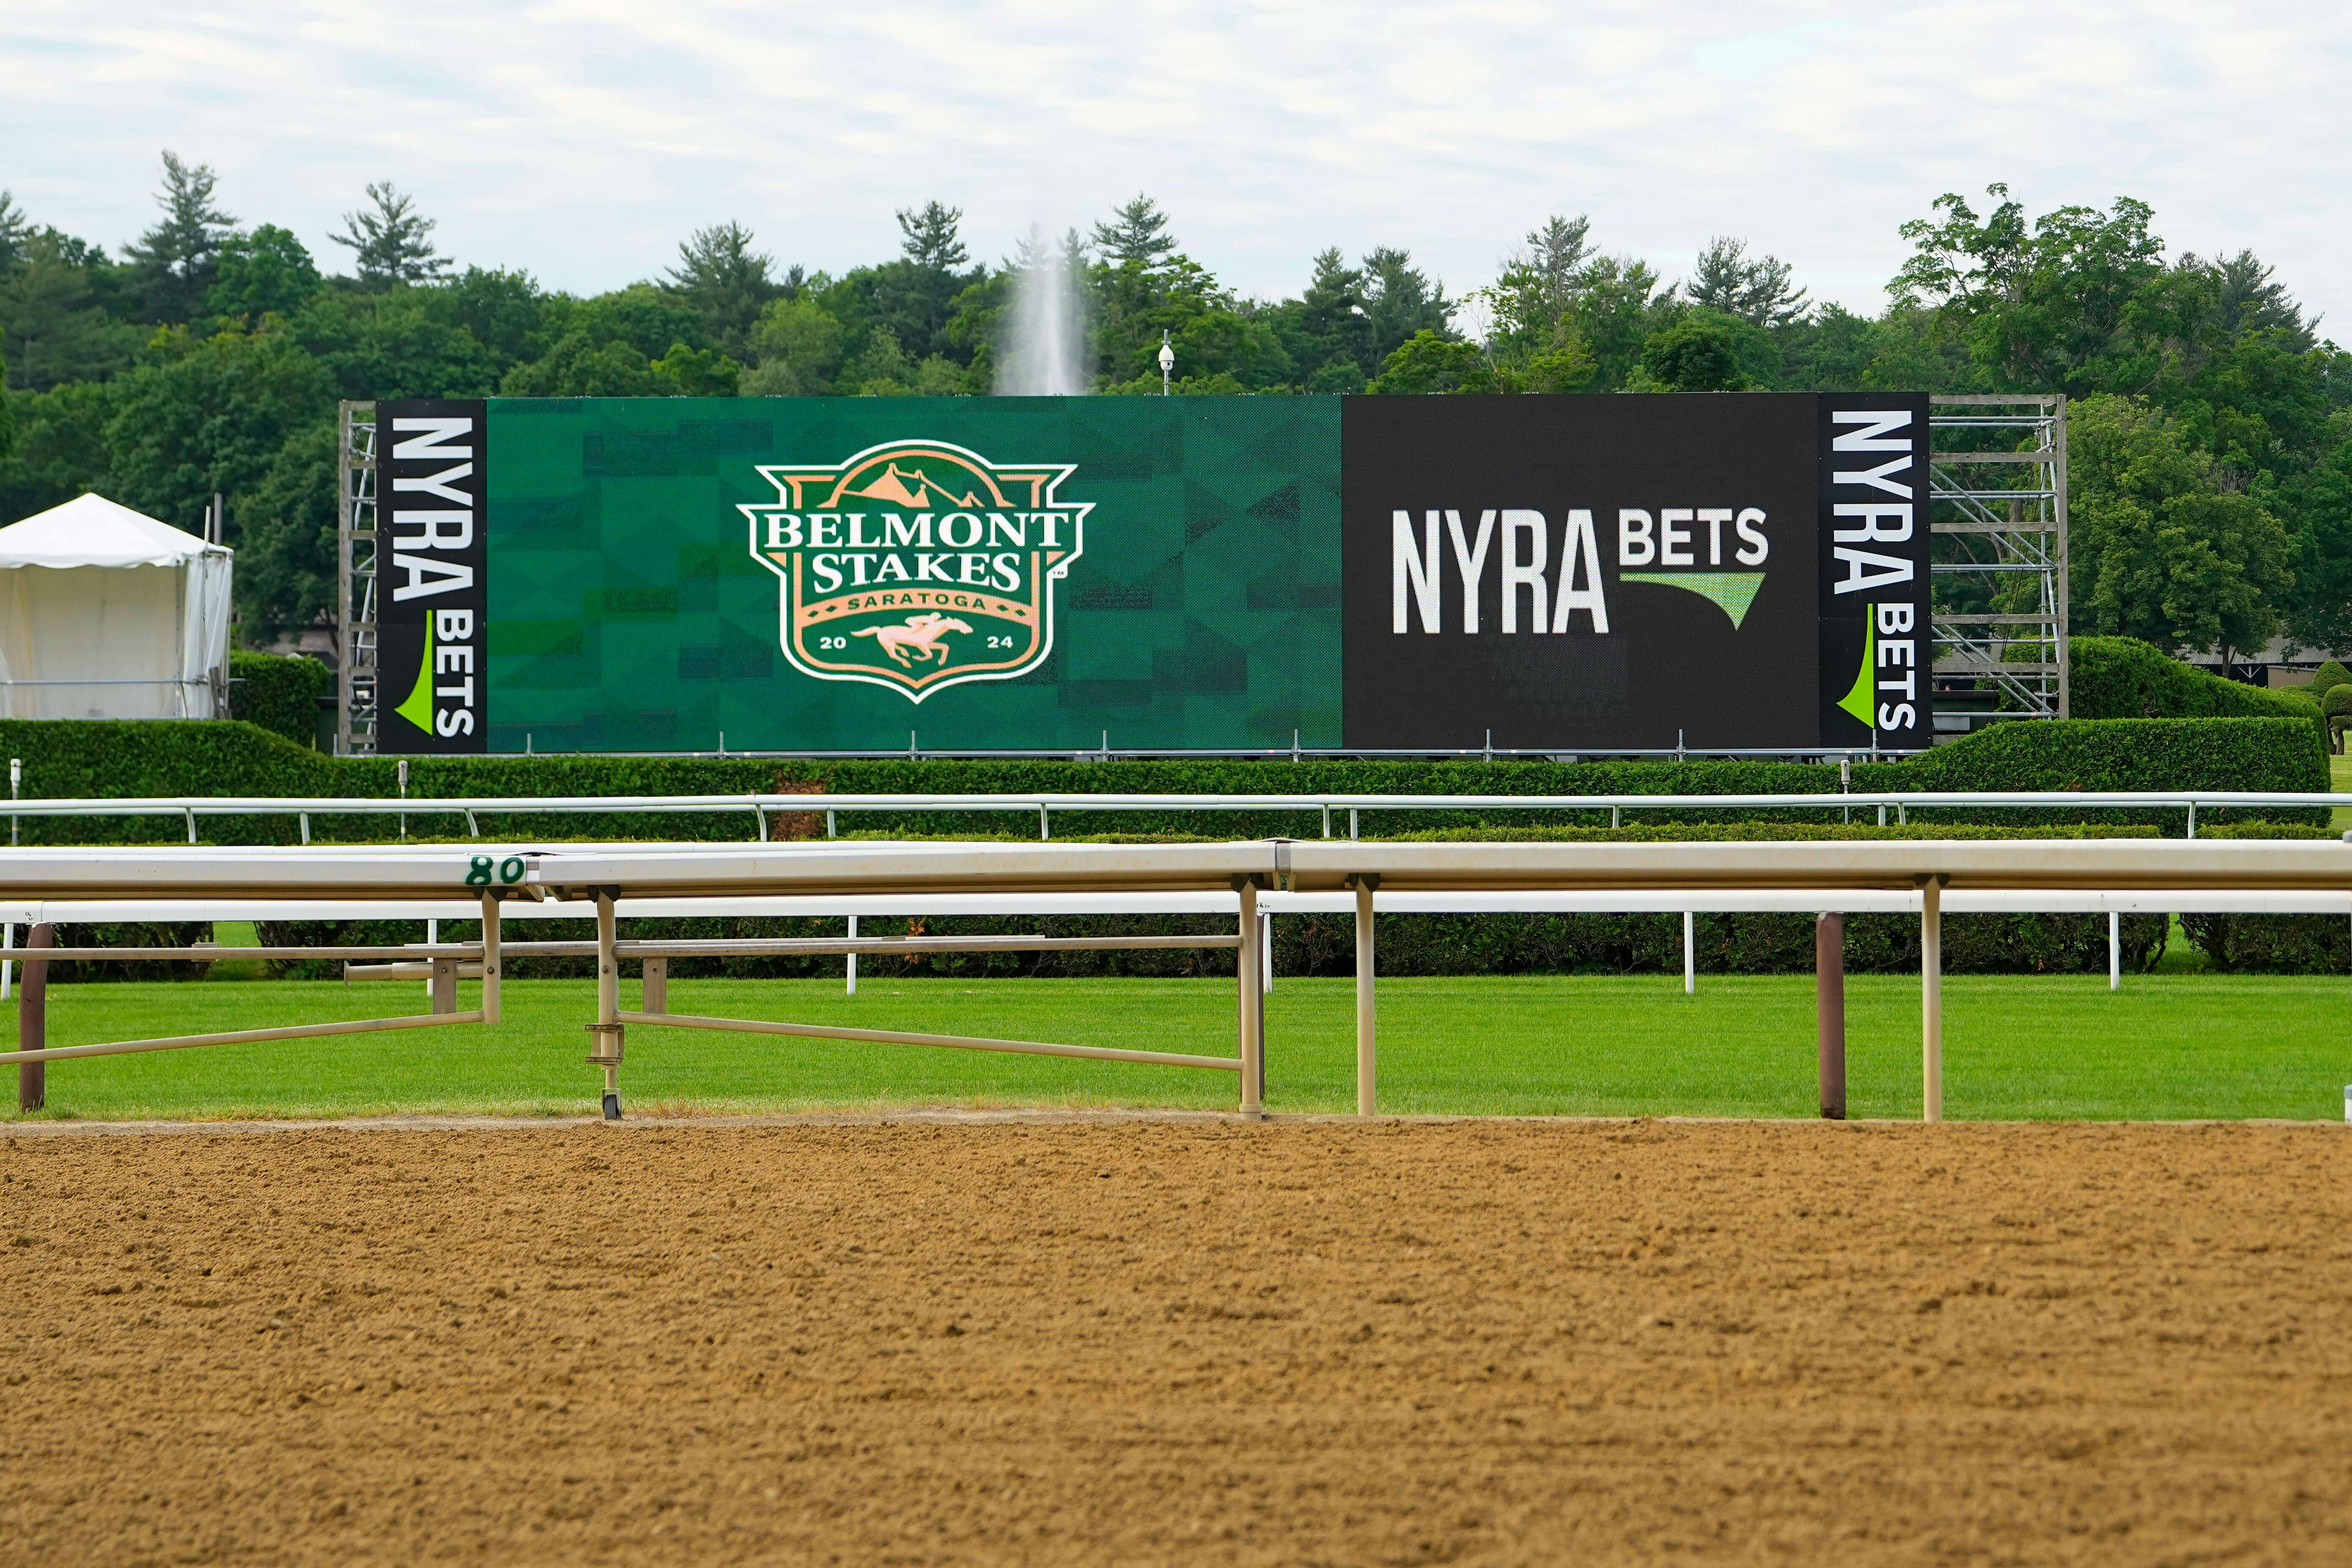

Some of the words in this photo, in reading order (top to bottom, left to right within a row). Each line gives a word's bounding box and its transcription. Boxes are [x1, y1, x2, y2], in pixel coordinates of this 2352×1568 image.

[764, 512, 1069, 548] BELMONT
[393, 418, 473, 602] NYRA
[436, 609, 474, 737] BETS
[812, 553, 1021, 594] STAKES
[1392, 509, 1609, 634] NYRA
[1619, 507, 1769, 566] BETS
[1832, 411, 1913, 595] NYRA
[1877, 603, 1915, 730] BETS
[847, 592, 985, 611] SARATOGA
[820, 636, 846, 649] 20
[987, 636, 1013, 648] 24
[465, 857, 524, 885] 80
